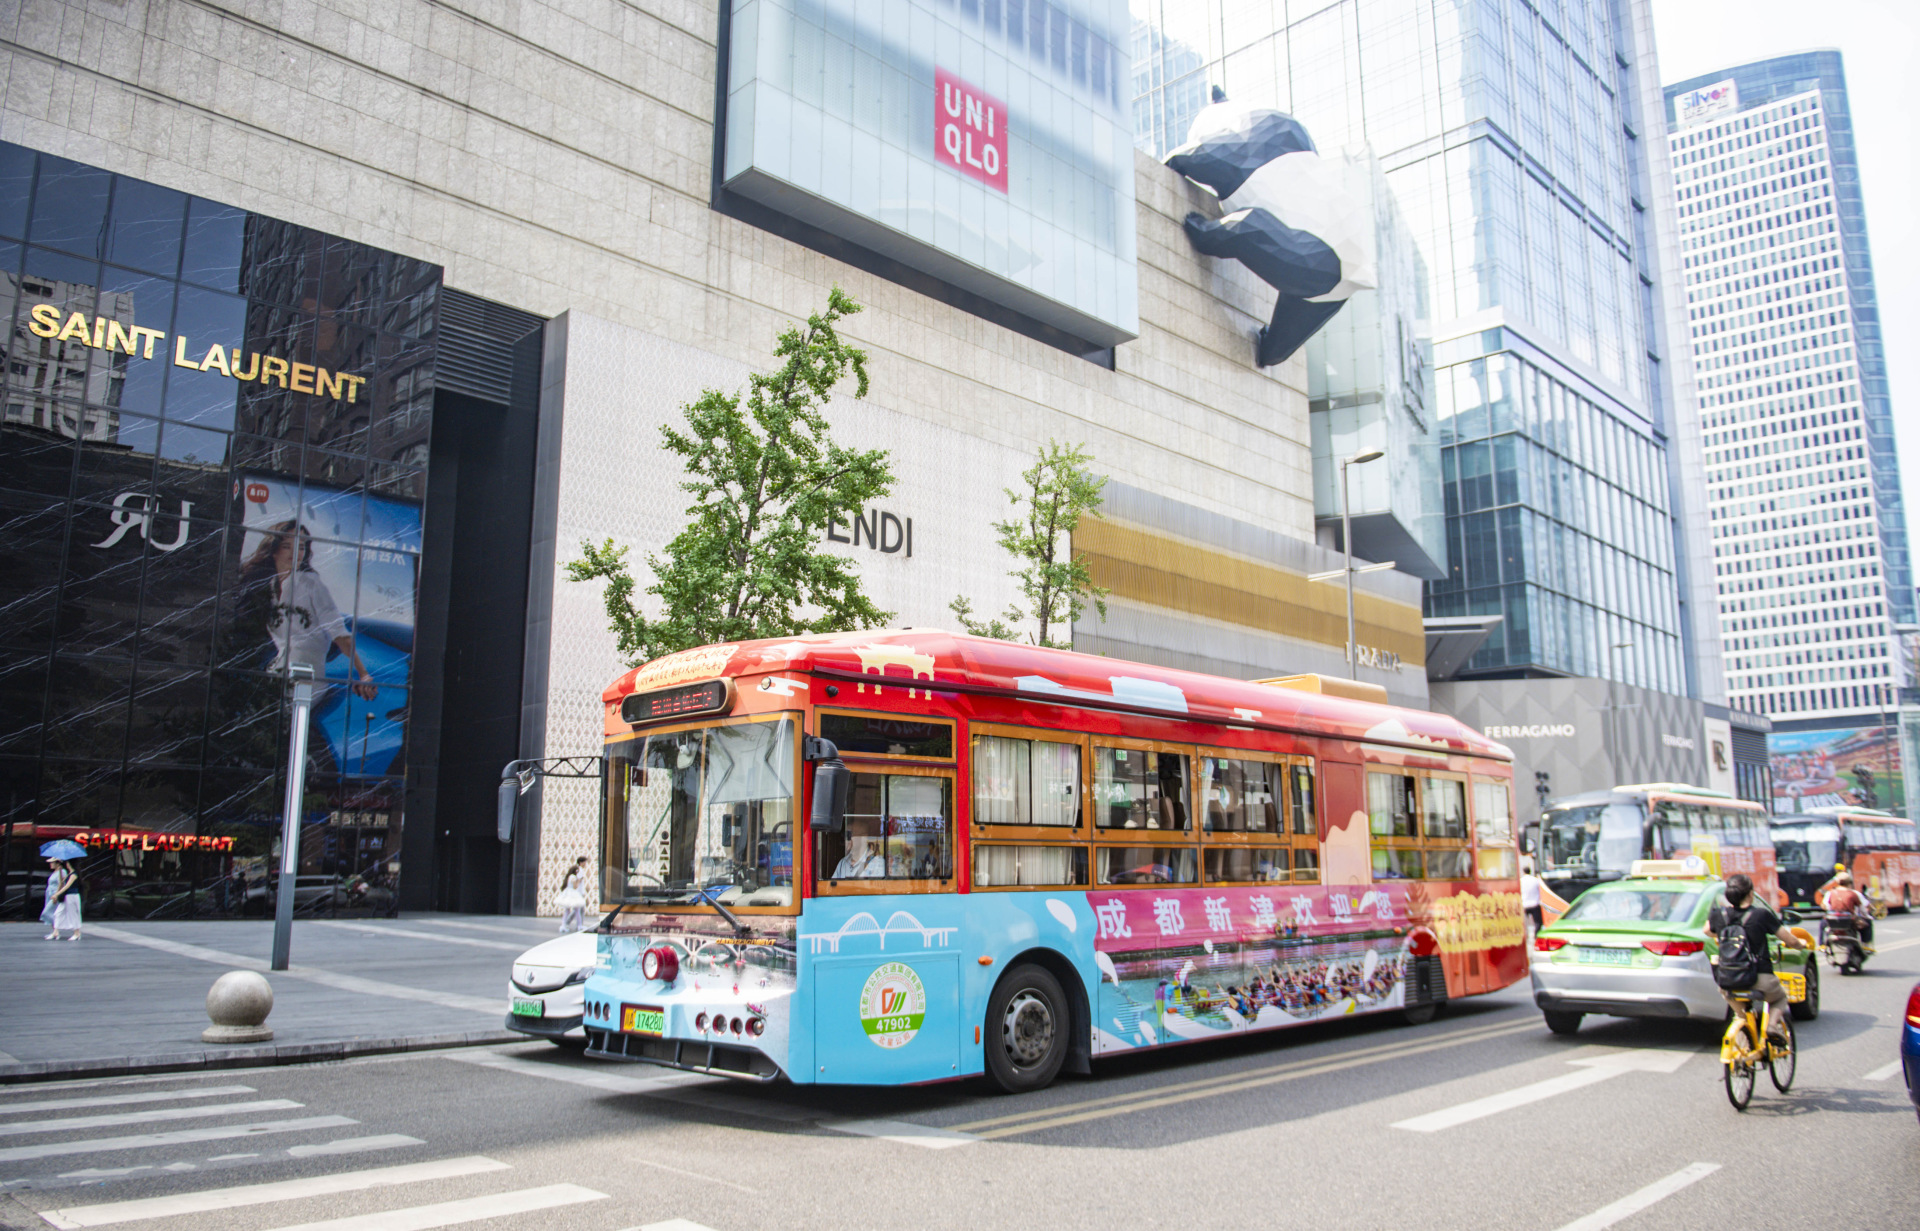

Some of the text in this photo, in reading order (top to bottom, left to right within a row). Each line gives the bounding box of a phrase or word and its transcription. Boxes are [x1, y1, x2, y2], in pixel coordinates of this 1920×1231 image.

[944, 82, 994, 138] UNI
[944, 123, 999, 176] QLO
[28, 304, 366, 404] SAINT LAURENT
[1484, 723, 1576, 739] FERRAGAMO
[75, 832, 236, 852] SAINT LAURENT
[1096, 892, 1396, 939] 成都新津欢迎您
[876, 1017, 911, 1032] 47902
